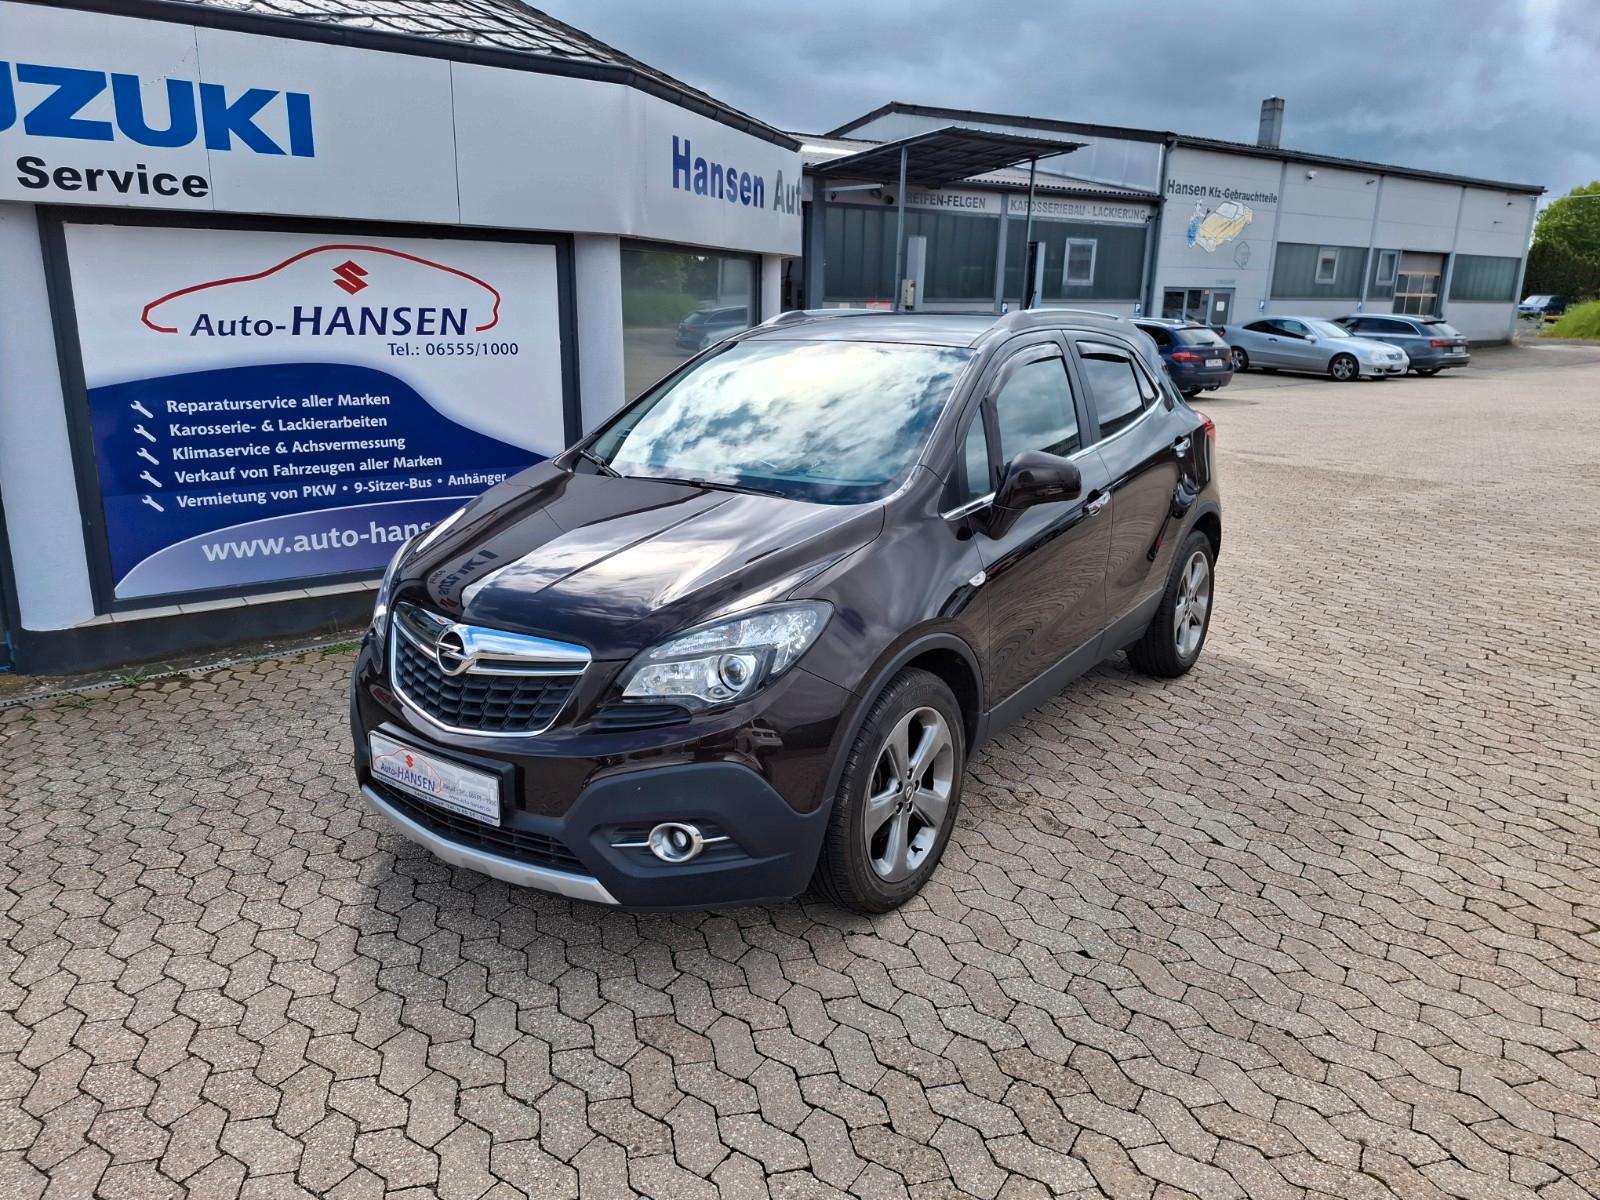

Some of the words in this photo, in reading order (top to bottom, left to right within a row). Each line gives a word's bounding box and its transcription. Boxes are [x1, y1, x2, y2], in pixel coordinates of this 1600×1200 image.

[0, 61, 315, 158] ZUKI
[16, 155, 209, 197] Service
[672, 135, 765, 208] Hansen
[905, 191, 986, 209] REIFEN-FELGEN
[1167, 179, 1206, 196] Hansen
[1208, 186, 1278, 203] Kfz-Gebrauchtteile
[1092, 206, 1146, 220] LACKIERUNG
[190, 306, 469, 337] Auto-HANSEN
[387, 342, 420, 356] Tel.:
[425, 341, 519, 357] 06555/1000
[167, 395, 297, 414] Reparaturservice
[301, 394, 334, 407] aller
[338, 393, 390, 407] Marken
[169, 421, 256, 437] Karosserie-
[261, 419, 274, 432] &
[278, 415, 388, 432] Lackierarbeiten
[172, 442, 271, 460] Klimaservice
[275, 441, 288, 454] &
[292, 436, 406, 454] Achsvermessung
[174, 467, 236, 484] Verkauf
[240, 466, 268, 479] von
[273, 461, 355, 479] Fahrzeugen
[359, 457, 389, 470] aller
[393, 454, 442, 468] Marken
[176, 490, 267, 508] Vermietung
[271, 488, 298, 500] von
[303, 484, 337, 497] PKW
[354, 476, 432, 493] 9-Sitzer-Bus
[448, 471, 507, 486] Anhänger
[380, 762, 435, 792] Auto-HANSEN
